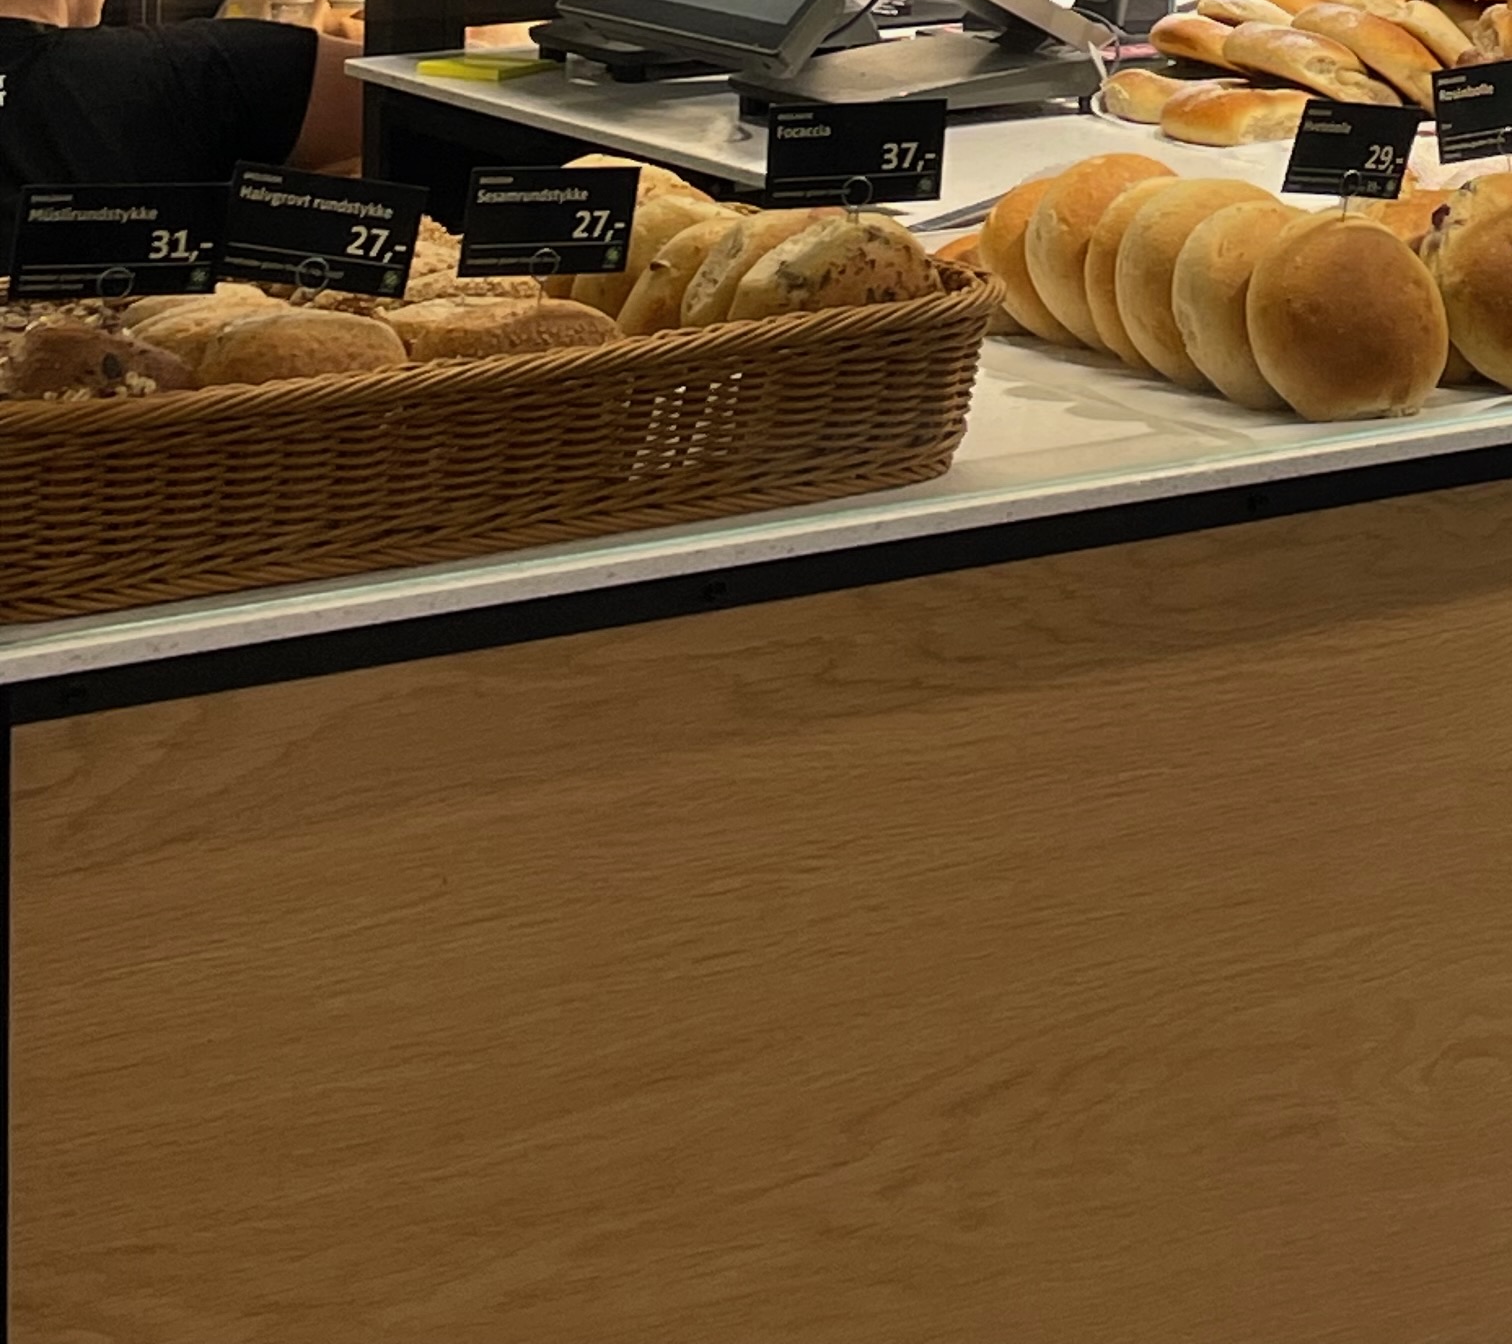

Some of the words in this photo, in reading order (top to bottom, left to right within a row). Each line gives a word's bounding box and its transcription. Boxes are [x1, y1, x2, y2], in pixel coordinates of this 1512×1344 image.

[776, 123, 832, 140] Focaccia
[880, 141, 937, 173] 37,-
[1364, 144, 1405, 177] 29,-
[571, 209, 626, 243] 27,-
[148, 229, 214, 263] 31,-
[345, 224, 408, 264] 27,-
